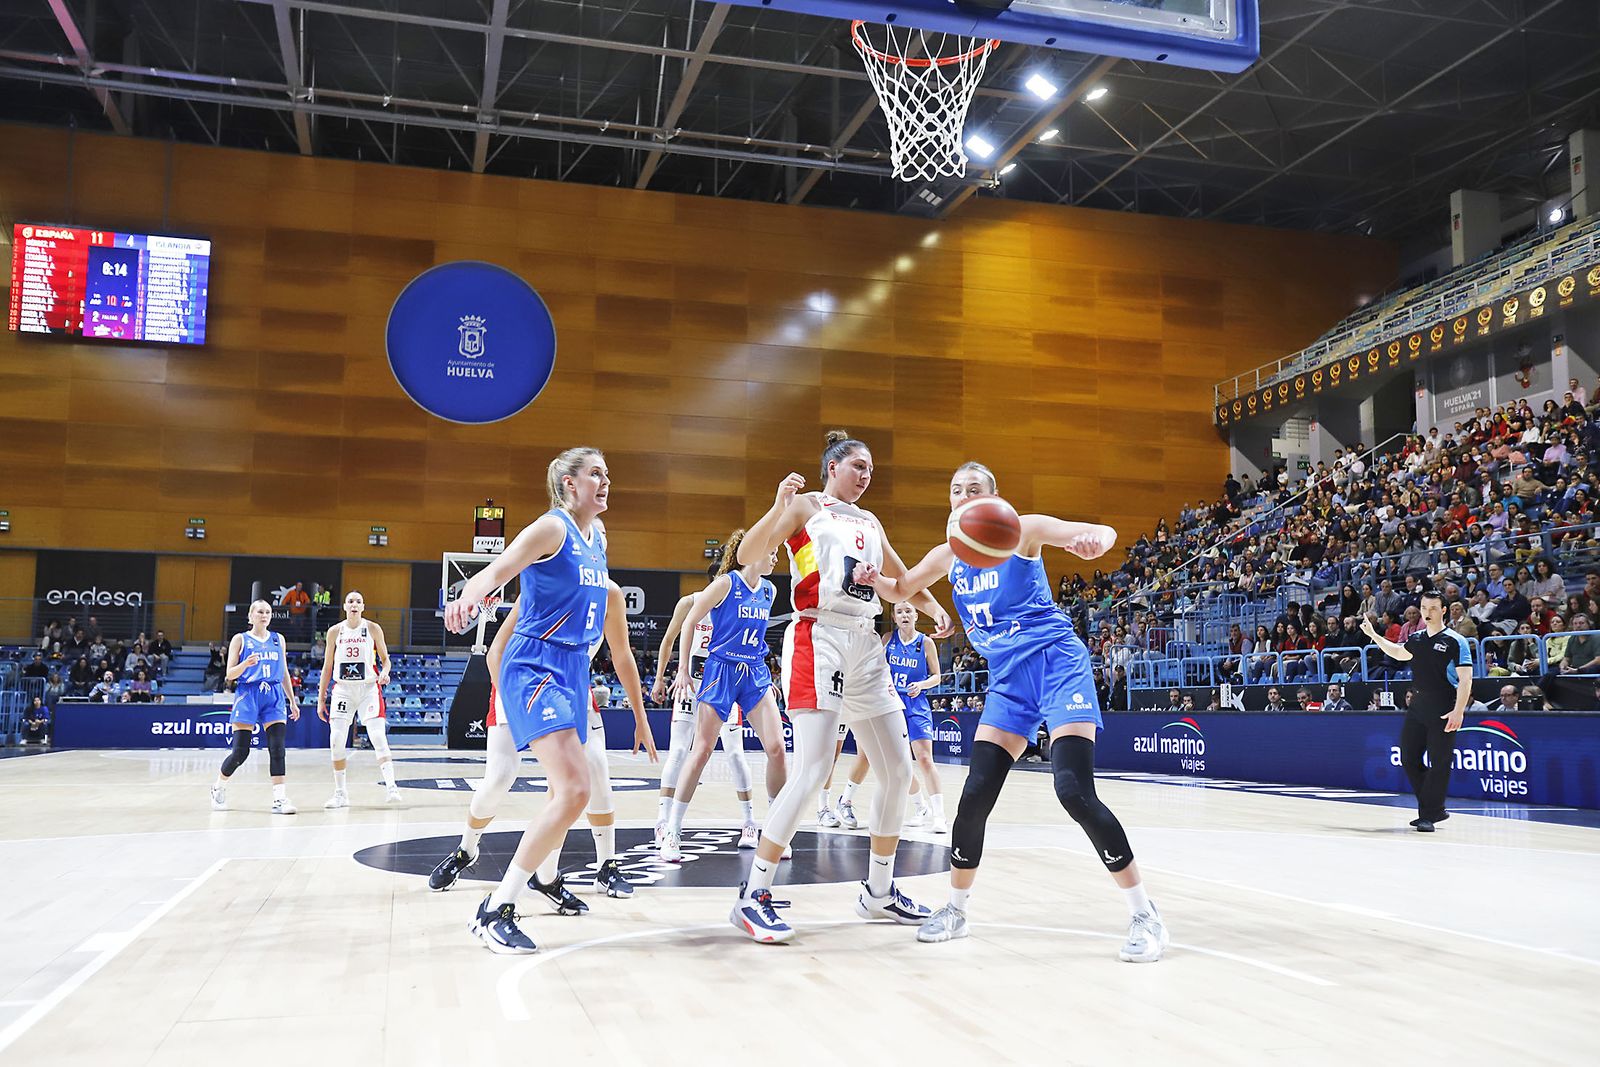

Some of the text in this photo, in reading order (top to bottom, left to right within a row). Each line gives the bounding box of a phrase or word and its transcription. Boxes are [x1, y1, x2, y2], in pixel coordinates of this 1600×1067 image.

[35, 229, 75, 240] ESPAÑA
[91, 232, 103, 244] 11
[126, 235, 134, 247] 4
[92, 311, 100, 322] 2
[121, 312, 129, 324] 4
[447, 366, 494, 378] HUELVA
[1444, 389, 1482, 408] HUELVA'21
[1450, 401, 1476, 414] ESPAÑA
[482, 508, 504, 518] 6:14
[476, 538, 502, 548] renfe
[856, 530, 864, 550] 8
[578, 564, 609, 590] ÍSLAN
[954, 570, 998, 596] ÍSLAND
[46, 586, 142, 606] endesa
[586, 602, 598, 630] 5
[738, 604, 769, 620] ÍSLAND
[966, 602, 994, 628] 77
[696, 624, 712, 632] ESP
[701, 636, 710, 649] 2
[742, 628, 759, 648] 14
[346, 646, 360, 658] 33
[726, 652, 756, 660] ICELANDAIR
[890, 654, 918, 668] ÍSLAND
[262, 664, 270, 678] 11
[832, 670, 844, 694] fi
[894, 672, 908, 688] 13
[338, 701, 346, 710] fi
[152, 718, 260, 735] azul maro
[939, 727, 962, 742] marino
[1134, 732, 1205, 756] azul marino
[1180, 756, 1206, 773] viajes
[1480, 774, 1528, 798] viajes
